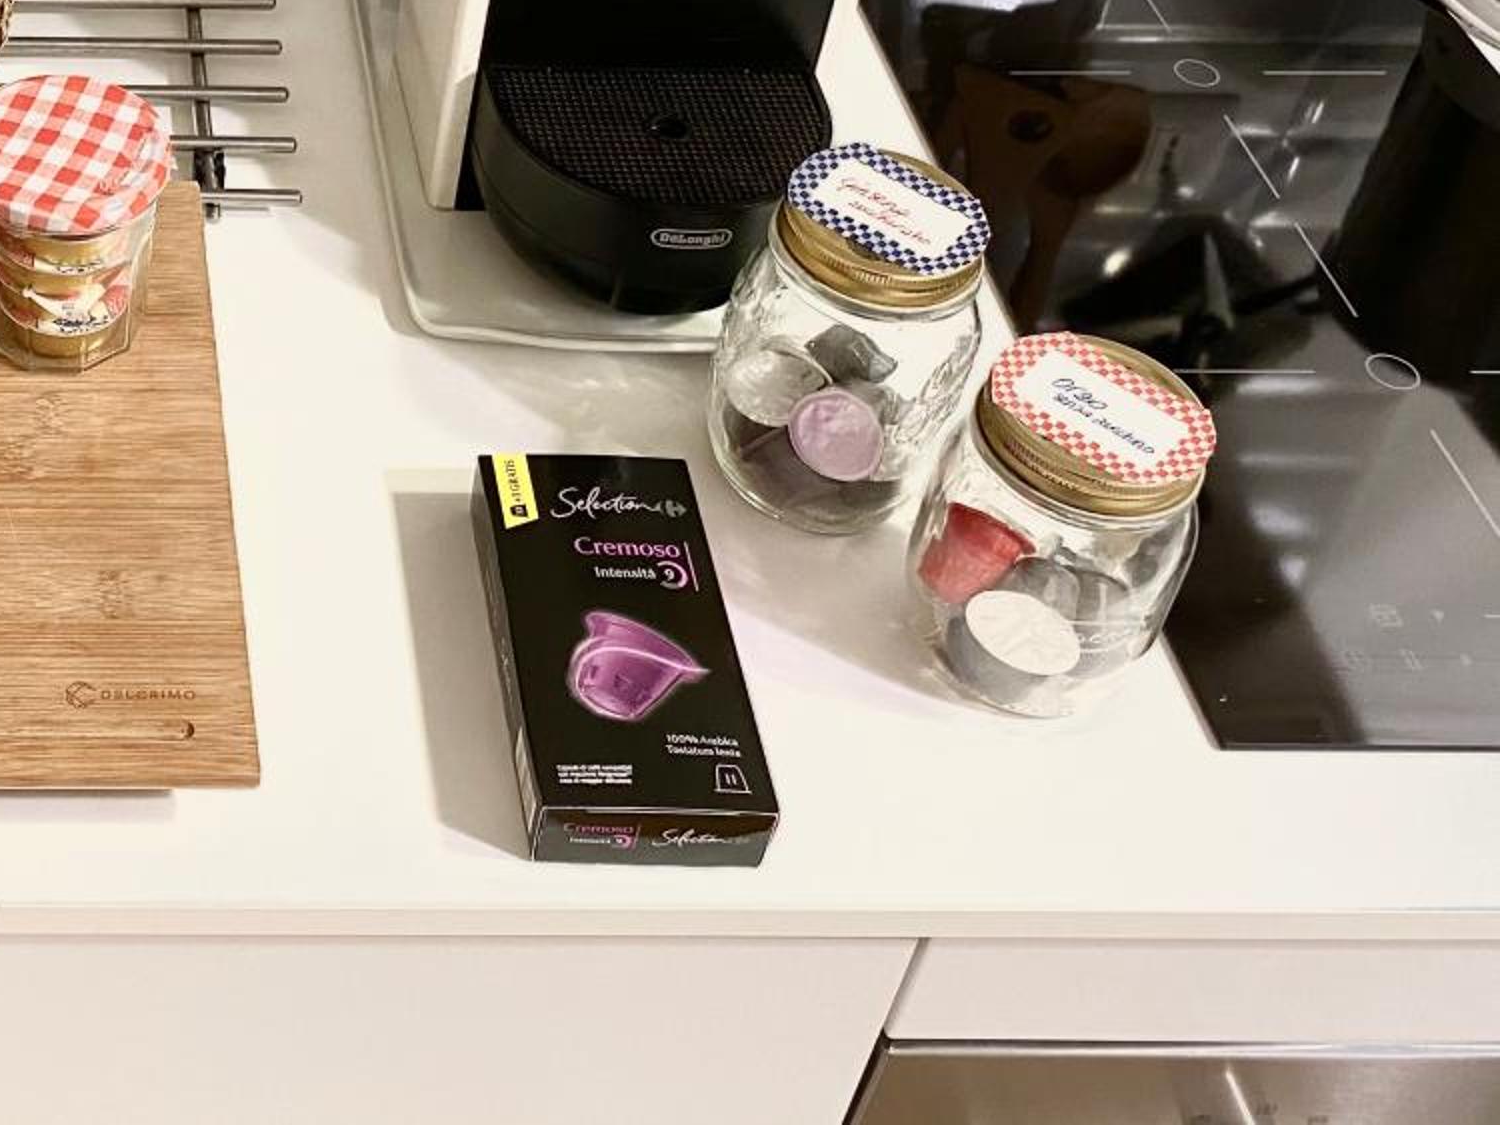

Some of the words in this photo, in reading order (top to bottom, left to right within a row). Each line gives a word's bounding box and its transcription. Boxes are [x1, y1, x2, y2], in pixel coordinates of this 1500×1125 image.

[551, 487, 661, 519] Selection
[574, 537, 680, 558] Cremoso
[665, 569, 674, 581] 9
